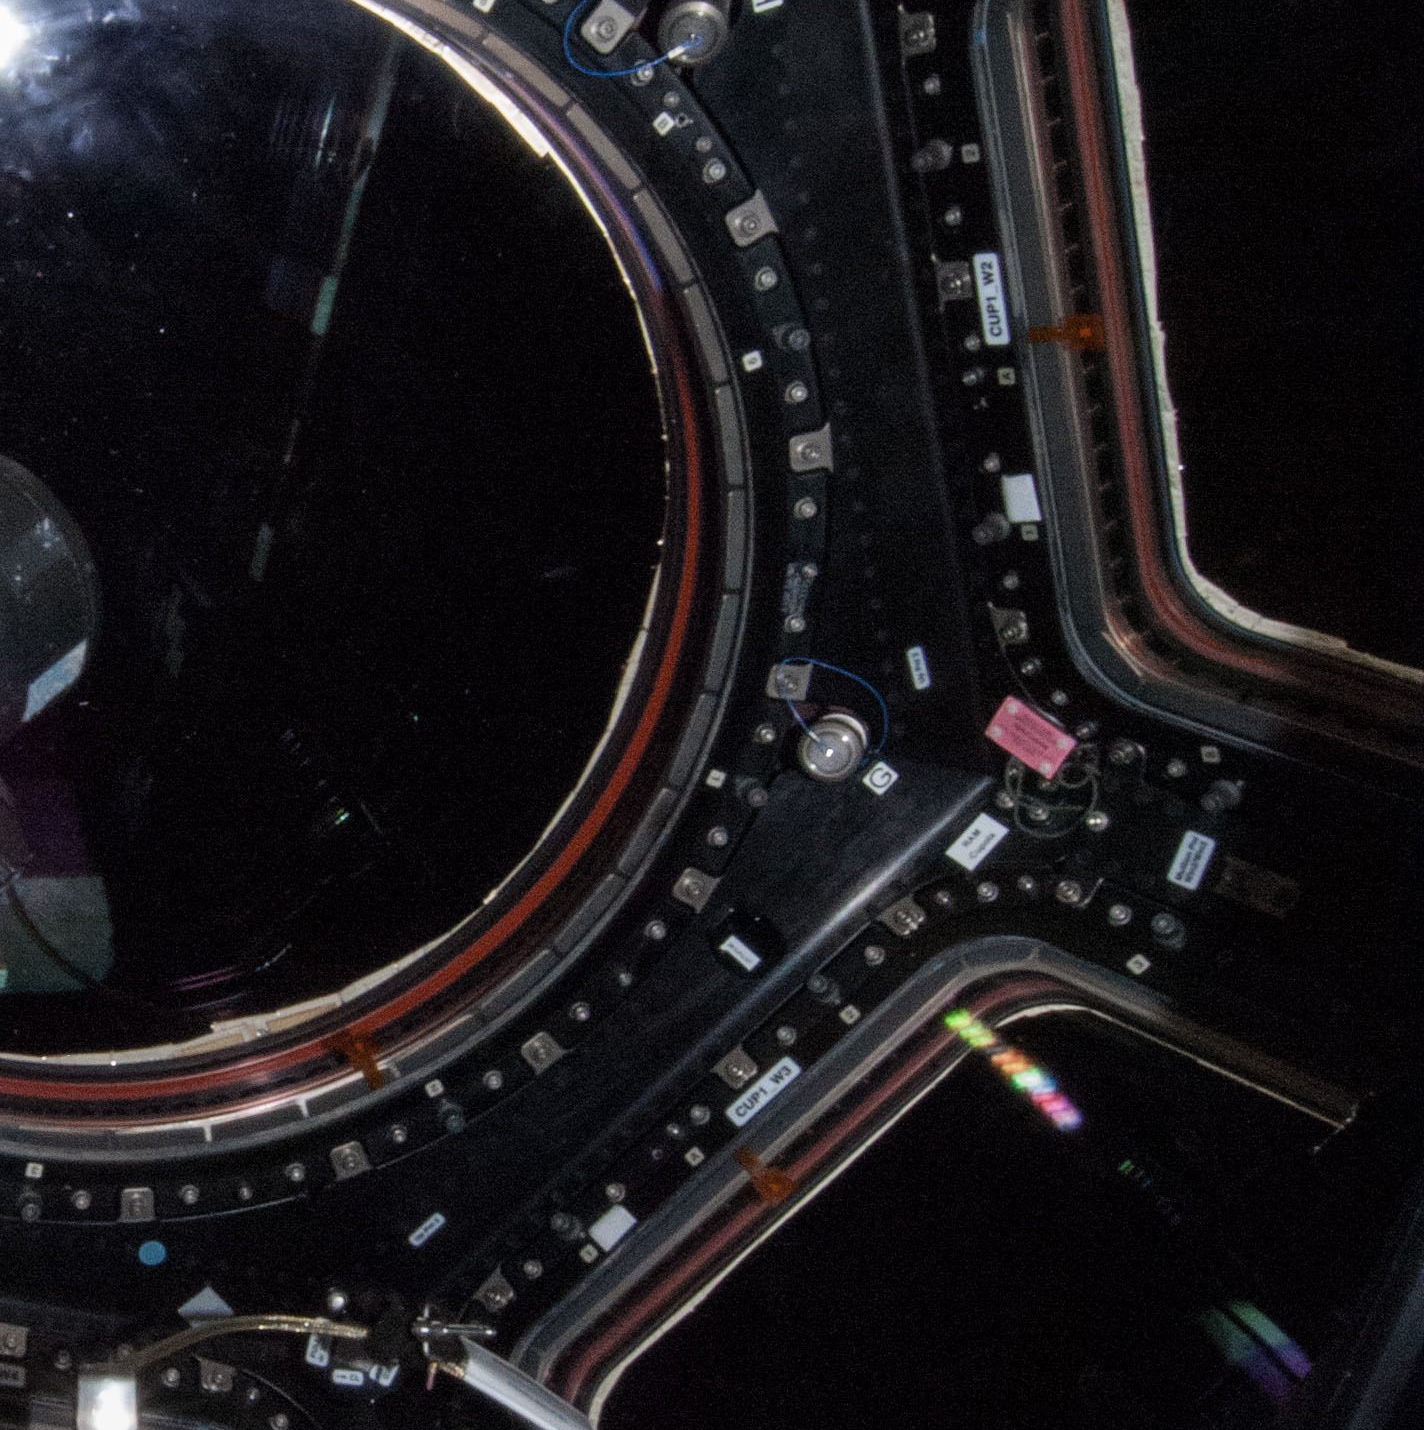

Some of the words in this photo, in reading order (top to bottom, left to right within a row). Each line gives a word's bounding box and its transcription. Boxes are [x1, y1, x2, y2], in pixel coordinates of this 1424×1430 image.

[980, 261, 1002, 336] CUP1_W2
[869, 767, 891, 787] G
[732, 1062, 795, 1121] CUP1_W3
